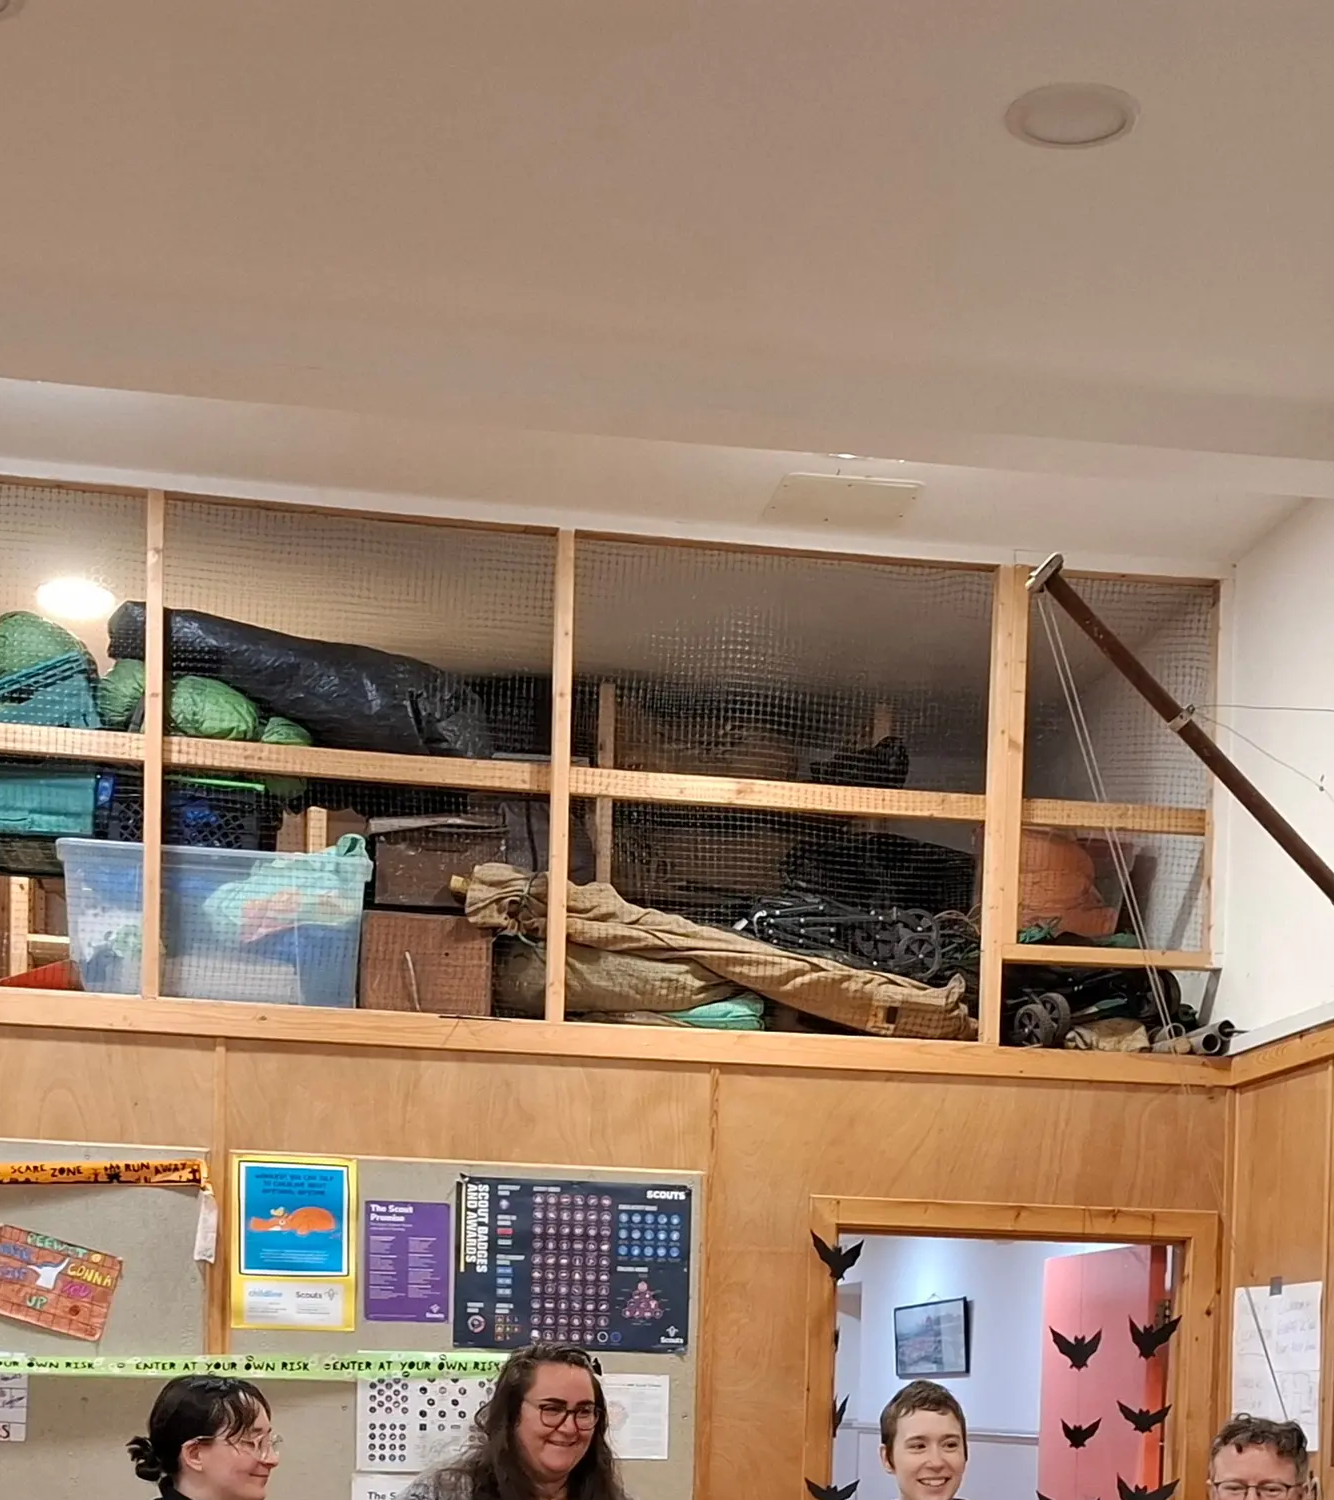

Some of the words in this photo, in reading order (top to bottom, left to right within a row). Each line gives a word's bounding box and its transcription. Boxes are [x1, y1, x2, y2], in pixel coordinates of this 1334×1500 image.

[10, 1163, 46, 1176] SCARE
[49, 1165, 84, 1178] ZONE
[123, 1162, 151, 1173] RUN
[153, 1162, 188, 1176] AWAY
[467, 1183, 478, 1209] AND
[646, 1190, 686, 1201] SCOUTS
[369, 1203, 387, 1213] The
[387, 1204, 414, 1214] Scout
[477, 1183, 490, 1224] SCOUT
[465, 1211, 478, 1264] AWARDS
[475, 1226, 489, 1273] BADGES
[295, 1290, 323, 1300] Scouts
[26, 1295, 48, 1309] UP
[660, 1335, 684, 1344] Scouts
[27, 1361, 60, 1369] OWN
[65, 1361, 96, 1370] RISK
[135, 1360, 177, 1371] ENTER
[182, 1361, 197, 1371] AT
[205, 1360, 238, 1372] YOUR
[244, 1360, 276, 1372] OWN
[281, 1361, 310, 1372] RISK
[332, 1360, 372, 1371] ENTER
[378, 1360, 394, 1371] AT
[399, 1360, 431, 1371] YOUR
[438, 1360, 468, 1372] OWN
[367, 1491, 387, 1500] The
